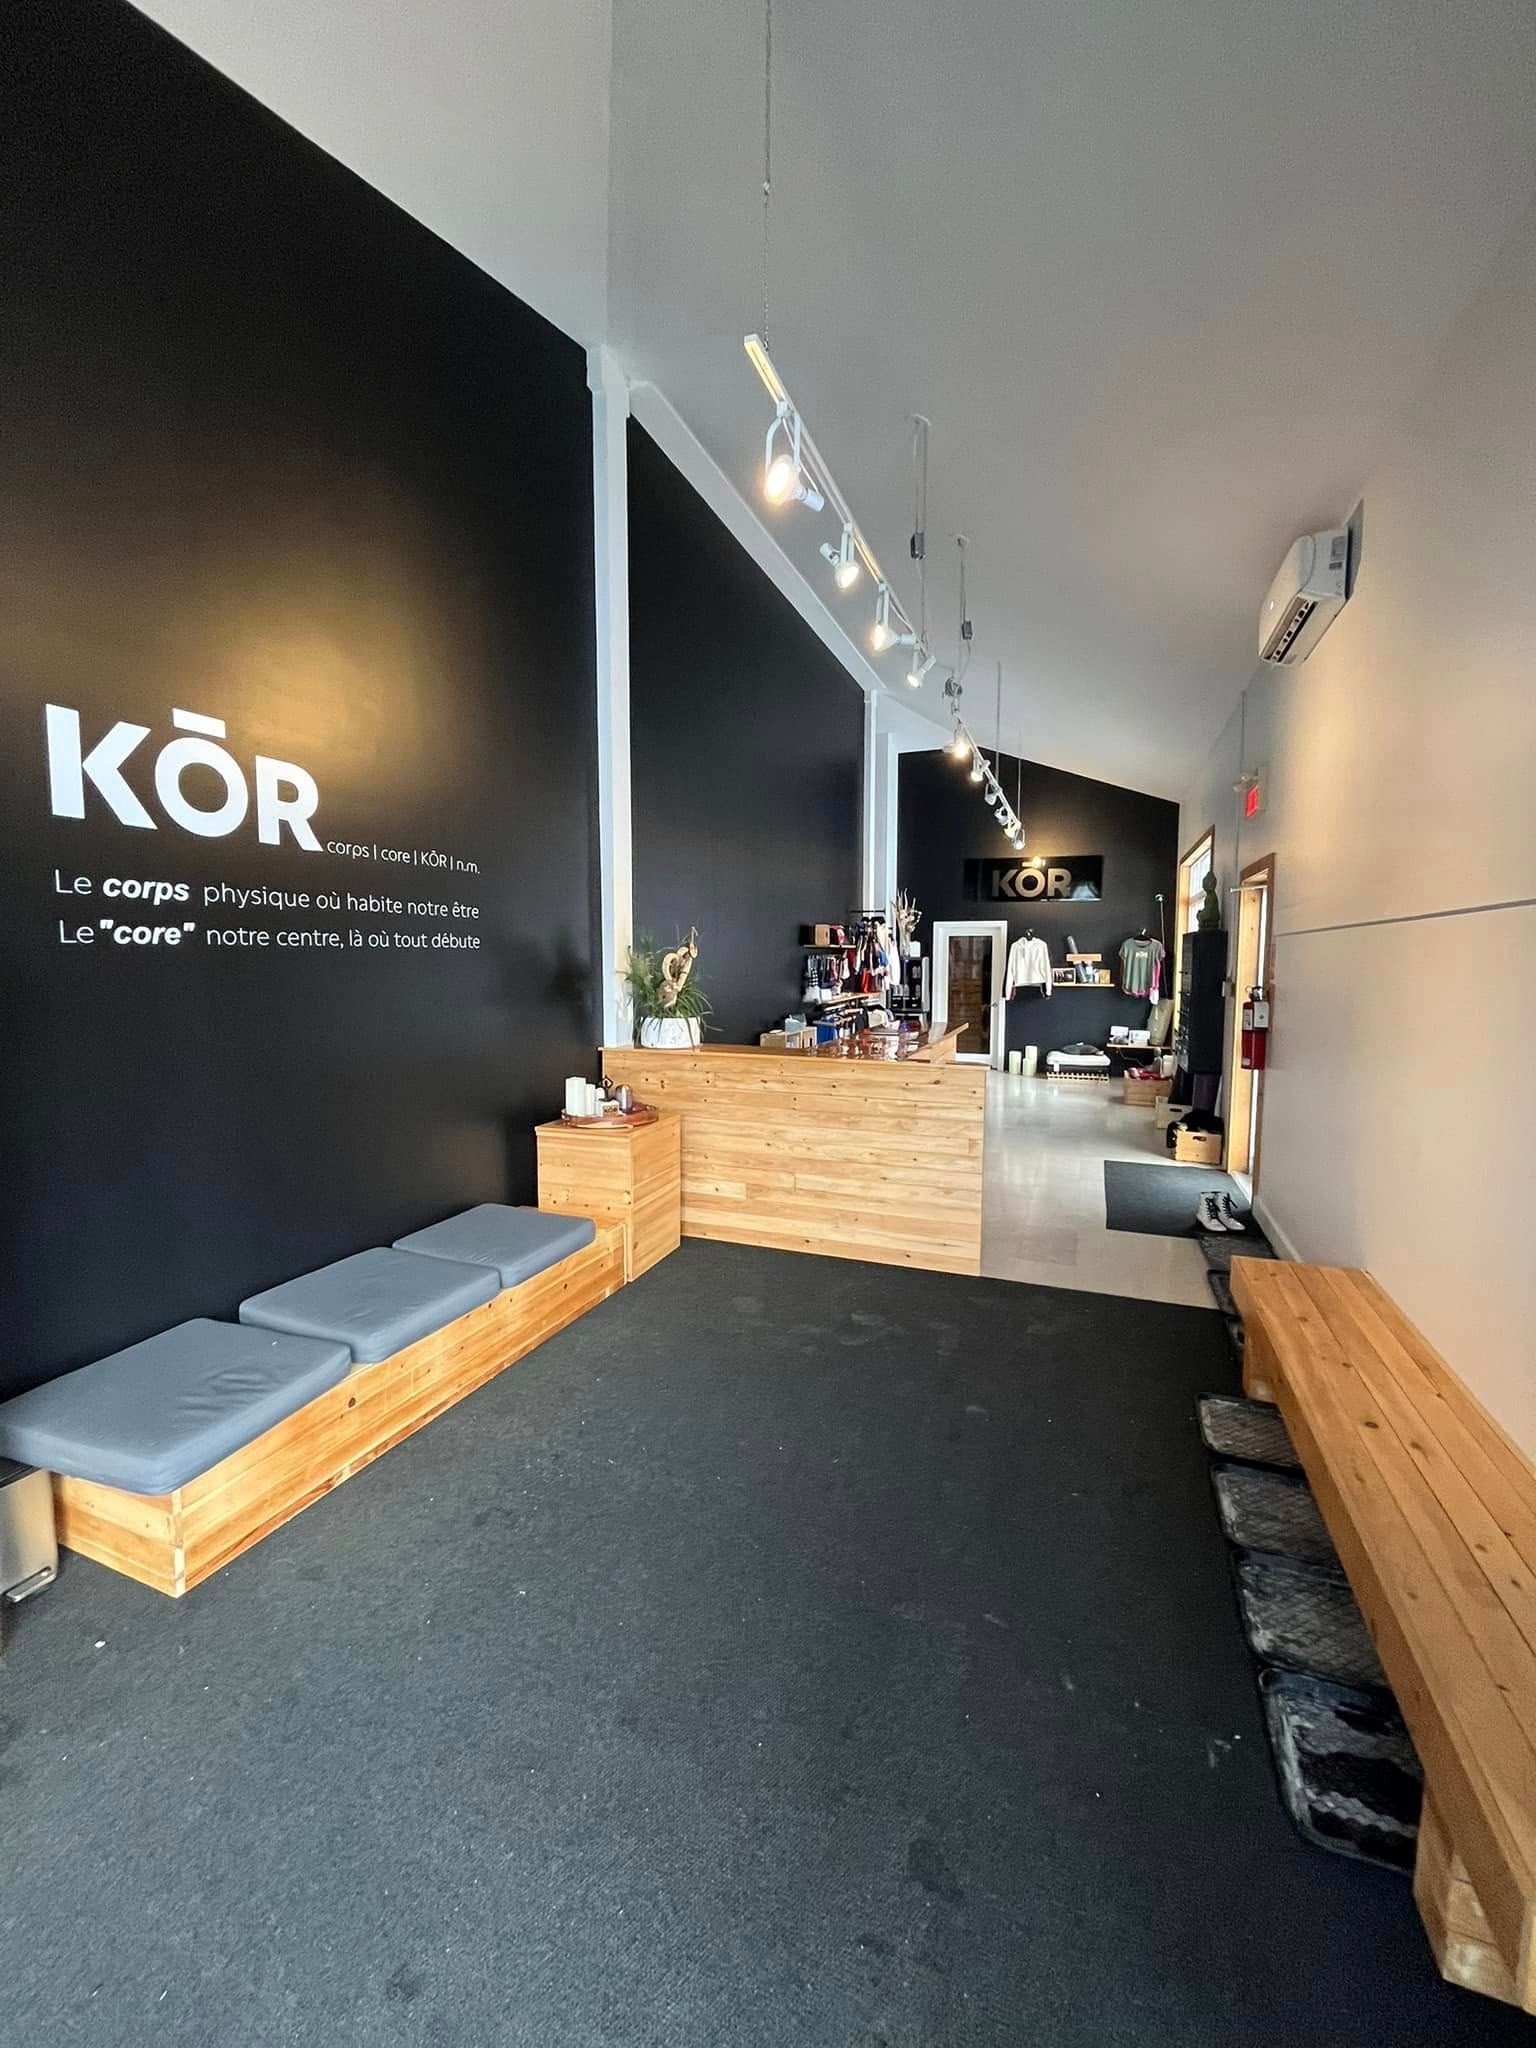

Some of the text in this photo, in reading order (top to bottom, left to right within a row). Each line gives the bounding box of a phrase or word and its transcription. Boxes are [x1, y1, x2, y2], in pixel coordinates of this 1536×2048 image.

[45, 703, 325, 852] KŌR
[326, 841, 370, 860] corps
[380, 848, 411, 864] core
[456, 859, 481, 874] n.m.
[54, 869, 480, 919] Le corps physique où habite notre être
[59, 918, 481, 950] Le "core" notre centre, là où tout débute
